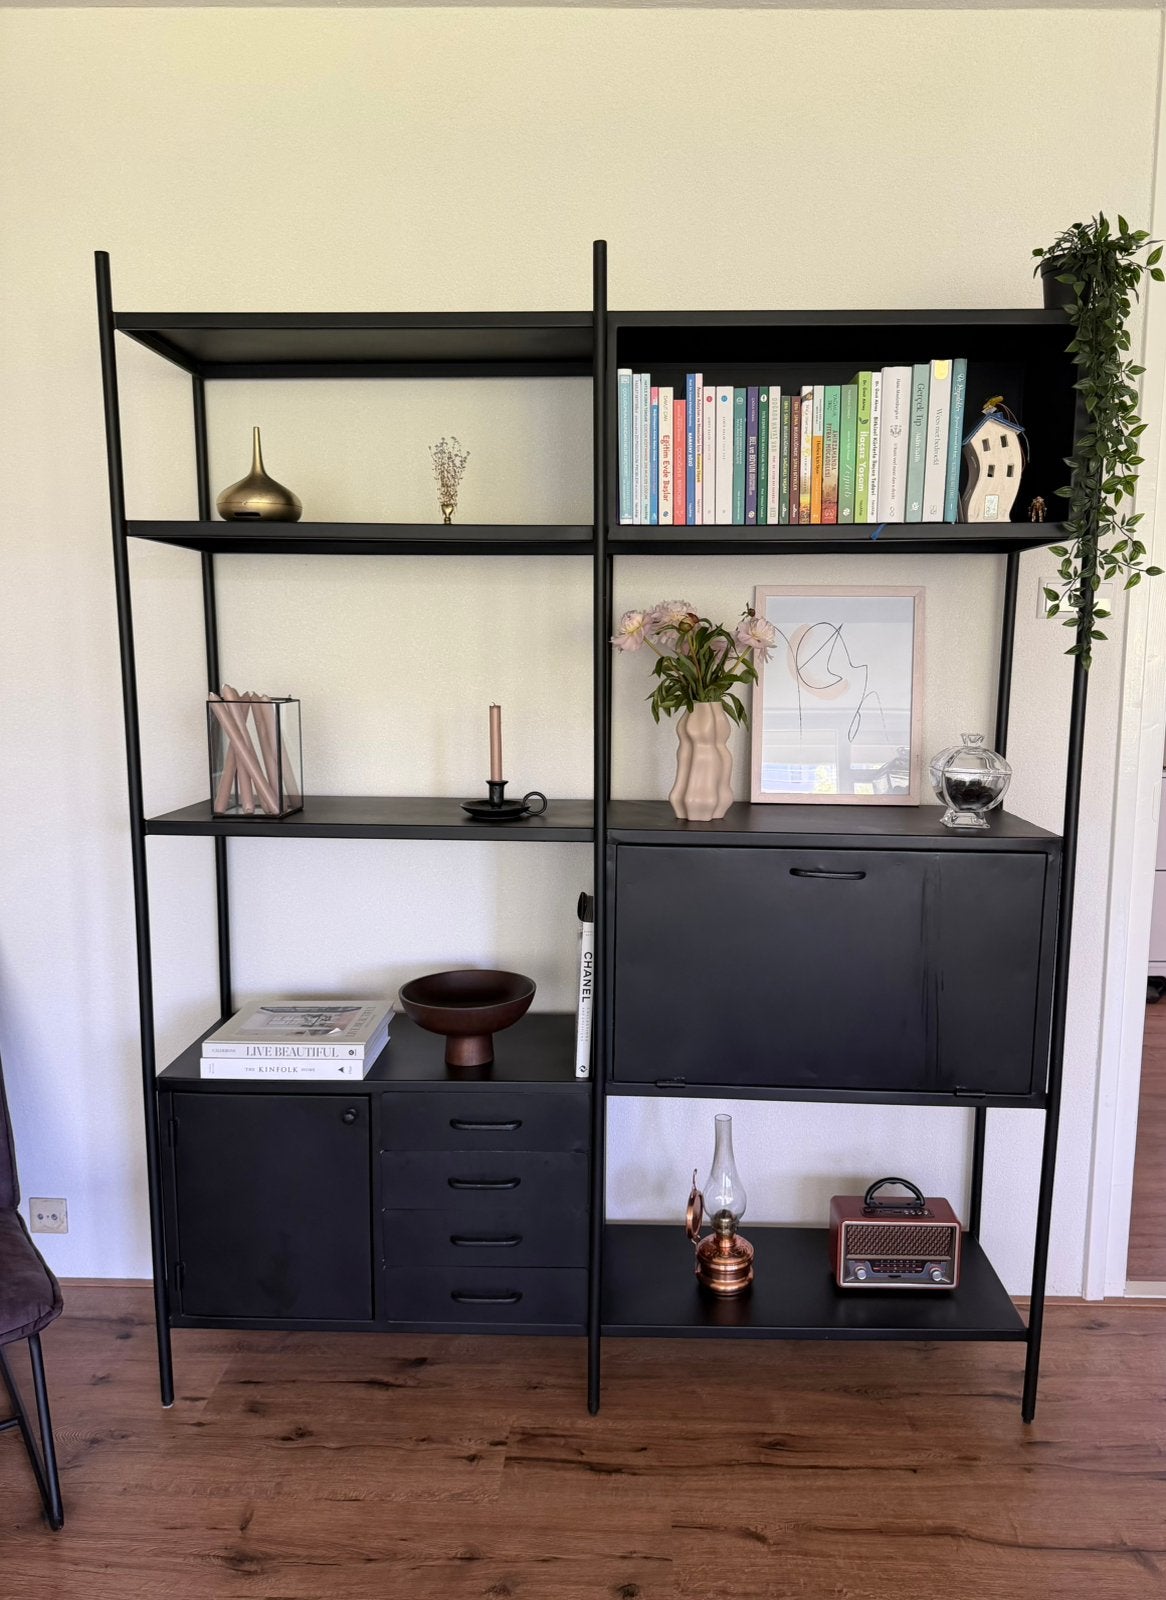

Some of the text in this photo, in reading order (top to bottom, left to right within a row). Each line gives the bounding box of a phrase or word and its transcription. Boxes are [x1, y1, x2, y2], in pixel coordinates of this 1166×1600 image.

[914, 383, 925, 413] Gerçek
[661, 435, 671, 502] Eğitim Evde Başlar
[857, 431, 869, 492] İlaçsız Yaşam
[581, 951, 593, 1003] CHANEL
[246, 1046, 339, 1058] LIVE BEAUTIFUL
